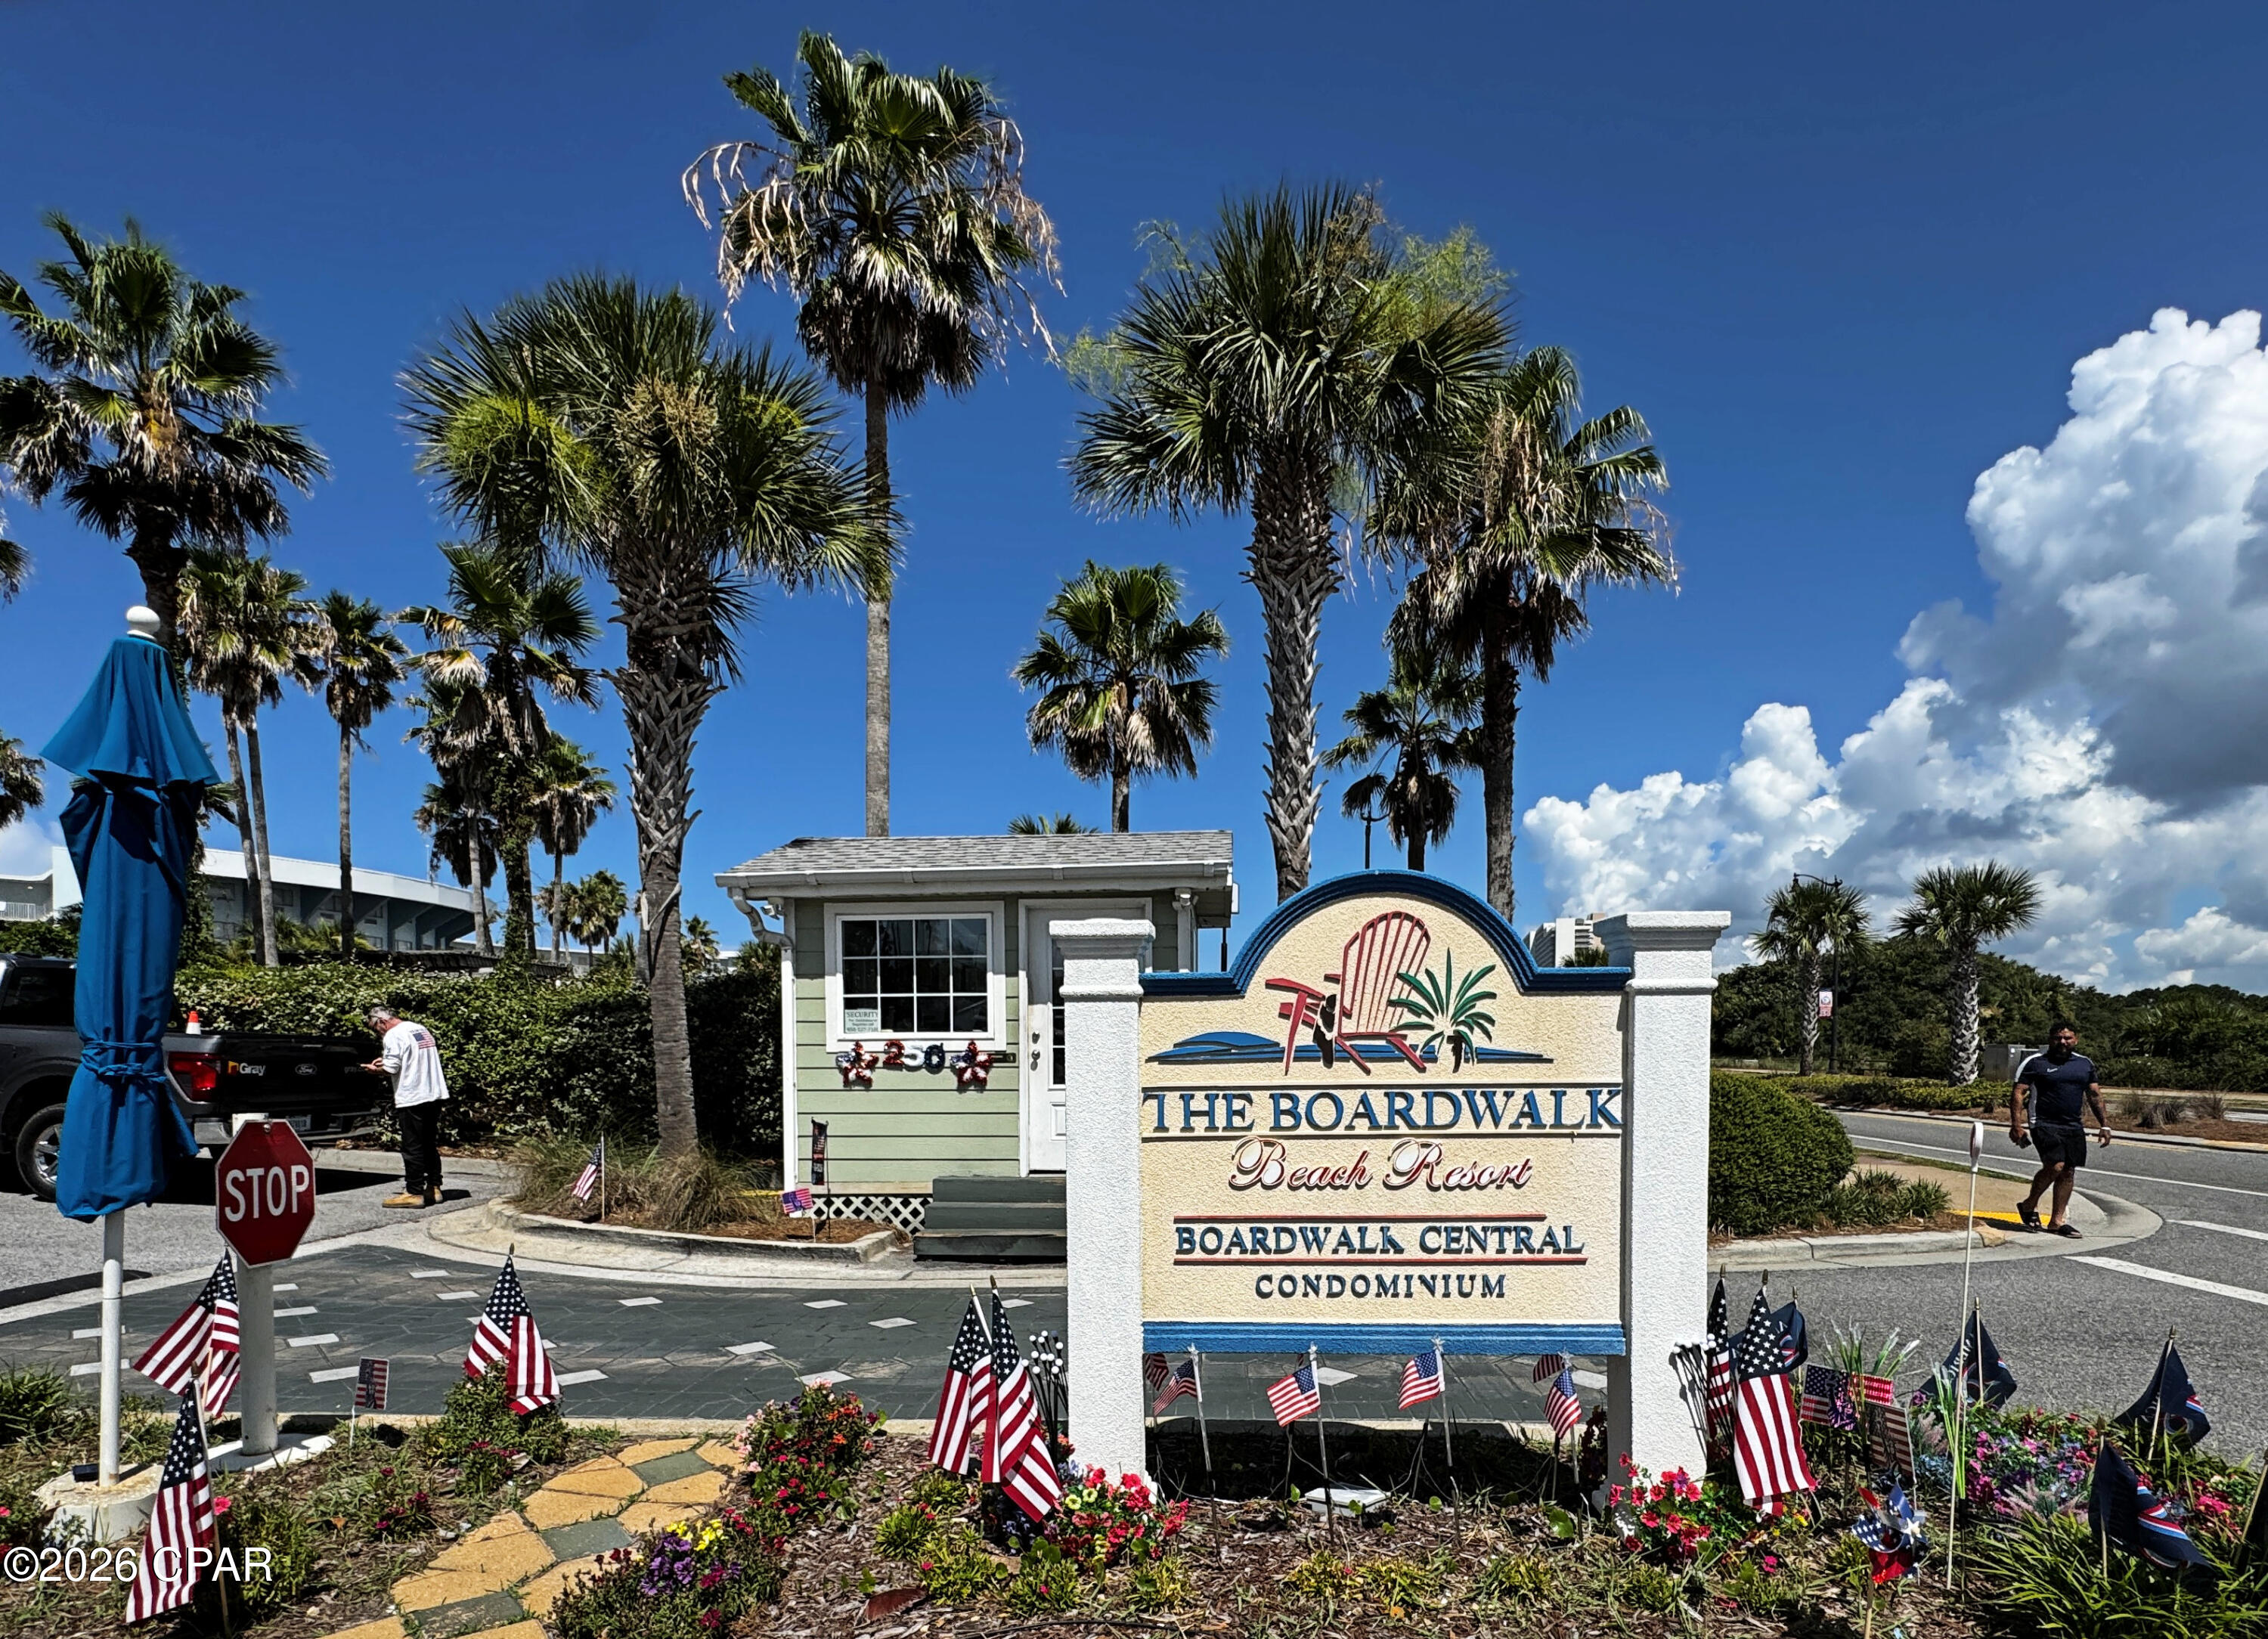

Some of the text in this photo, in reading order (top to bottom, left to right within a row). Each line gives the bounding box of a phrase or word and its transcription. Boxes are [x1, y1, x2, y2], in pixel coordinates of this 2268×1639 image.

[883, 1040, 945, 1067] 250
[239, 1063, 265, 1076] Gray
[1142, 1089, 1623, 1132] THE BOARDWALK
[1228, 1136, 1533, 1191] Beach Resort
[225, 1165, 309, 1222] STOP
[1175, 1225, 1585, 1256] BOARDWALK CENTRAL
[1255, 1273, 1506, 1299] CONDOMINIUM
